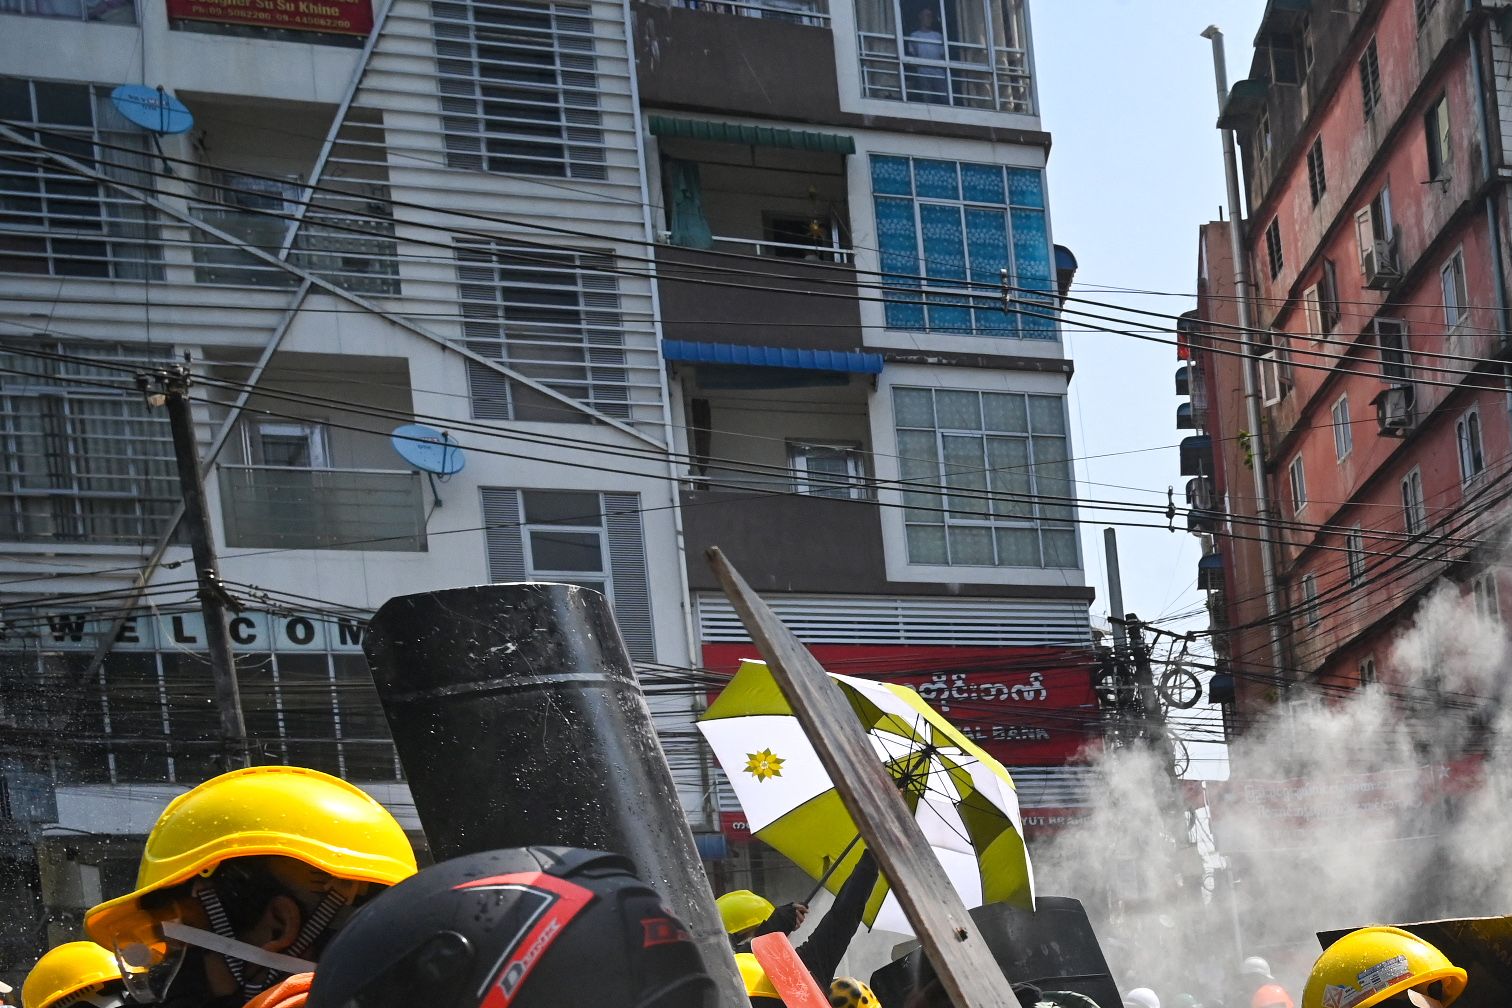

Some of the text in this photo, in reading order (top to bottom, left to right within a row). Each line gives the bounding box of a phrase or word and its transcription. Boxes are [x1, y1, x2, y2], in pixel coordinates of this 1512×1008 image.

[275, 1, 295, 12] Su
[299, 2, 340, 17] Khine
[957, 726, 1050, 740] AL BANK
[1020, 816, 1045, 826] YUT
